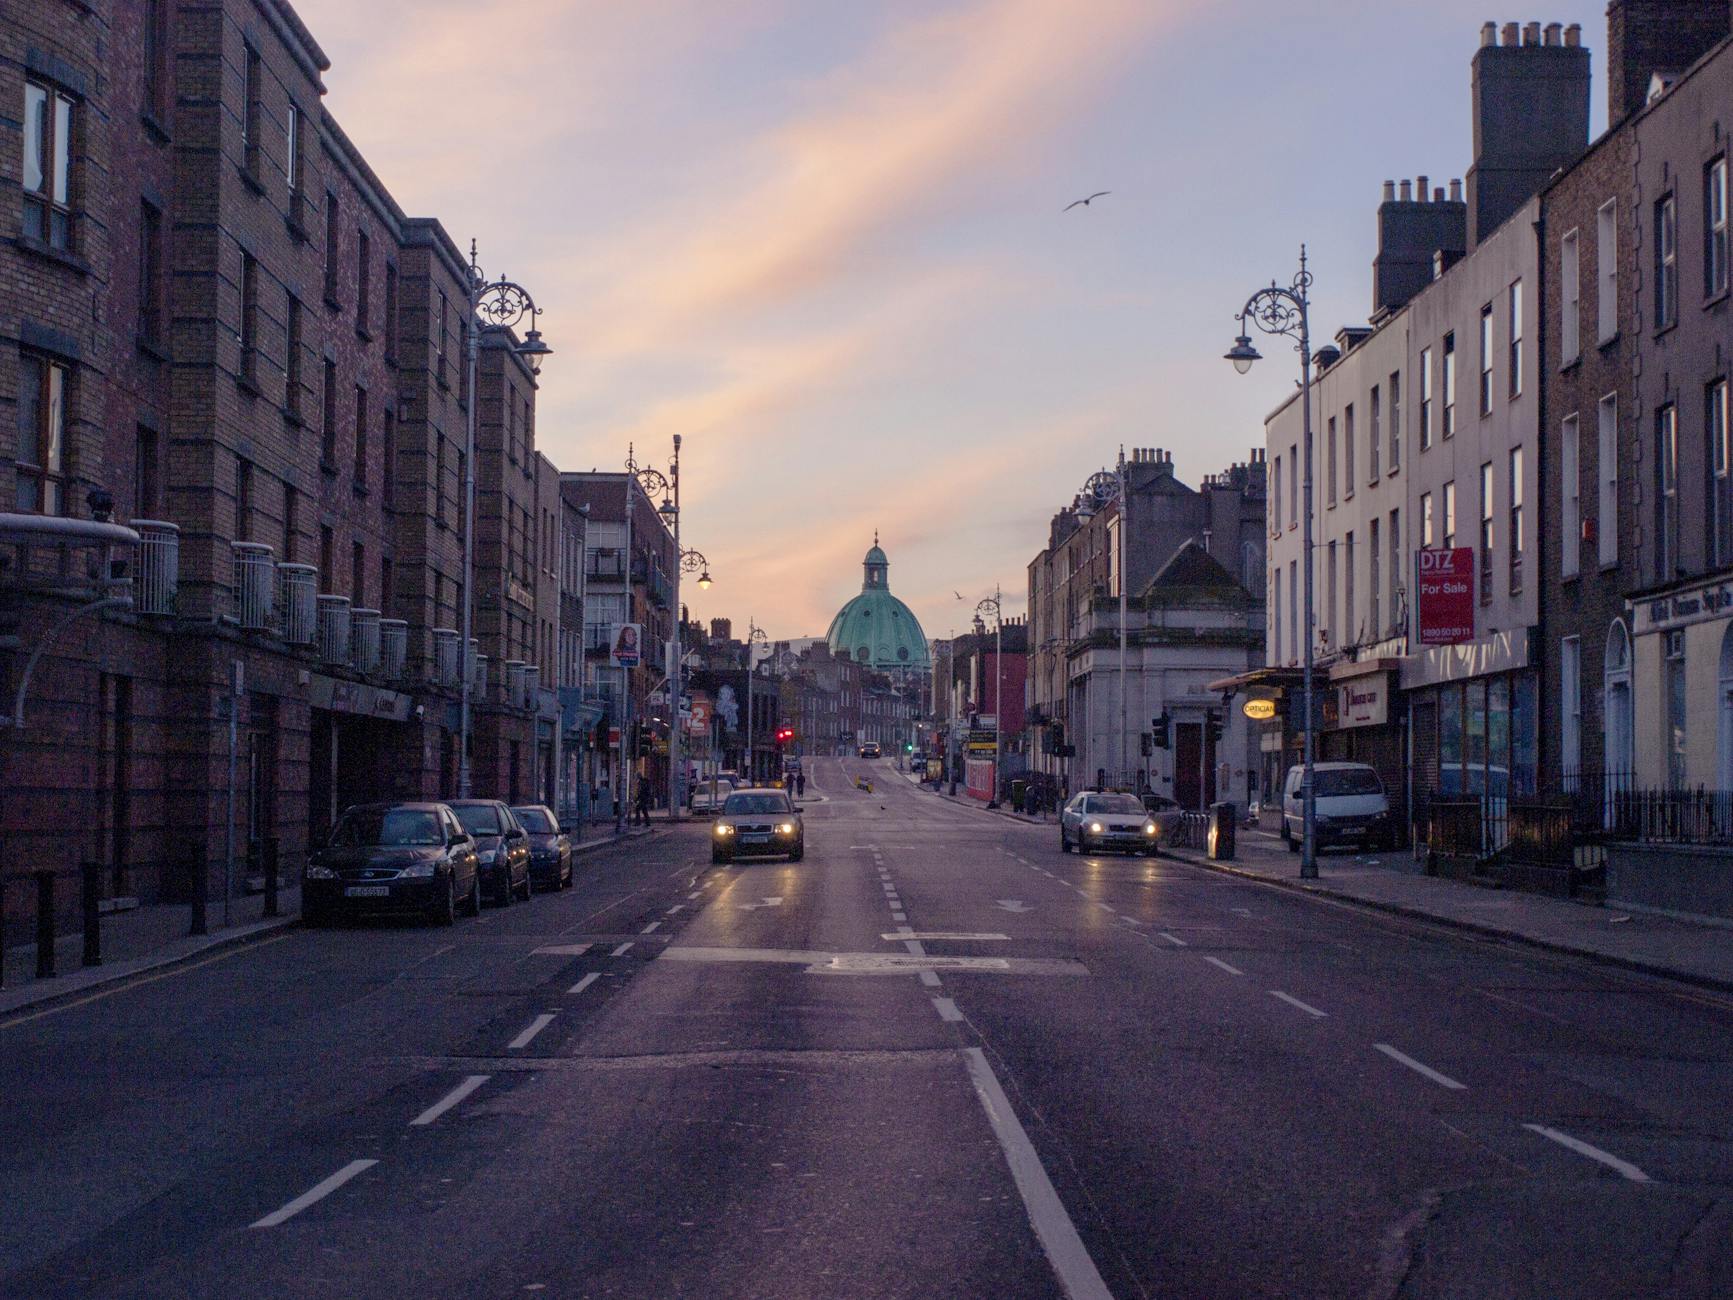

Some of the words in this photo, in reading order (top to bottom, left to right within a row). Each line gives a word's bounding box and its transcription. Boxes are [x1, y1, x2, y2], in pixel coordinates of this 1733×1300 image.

[1421, 550, 1454, 570] DTZ
[1422, 584, 1440, 595] For
[1443, 582, 1468, 593] Sale
